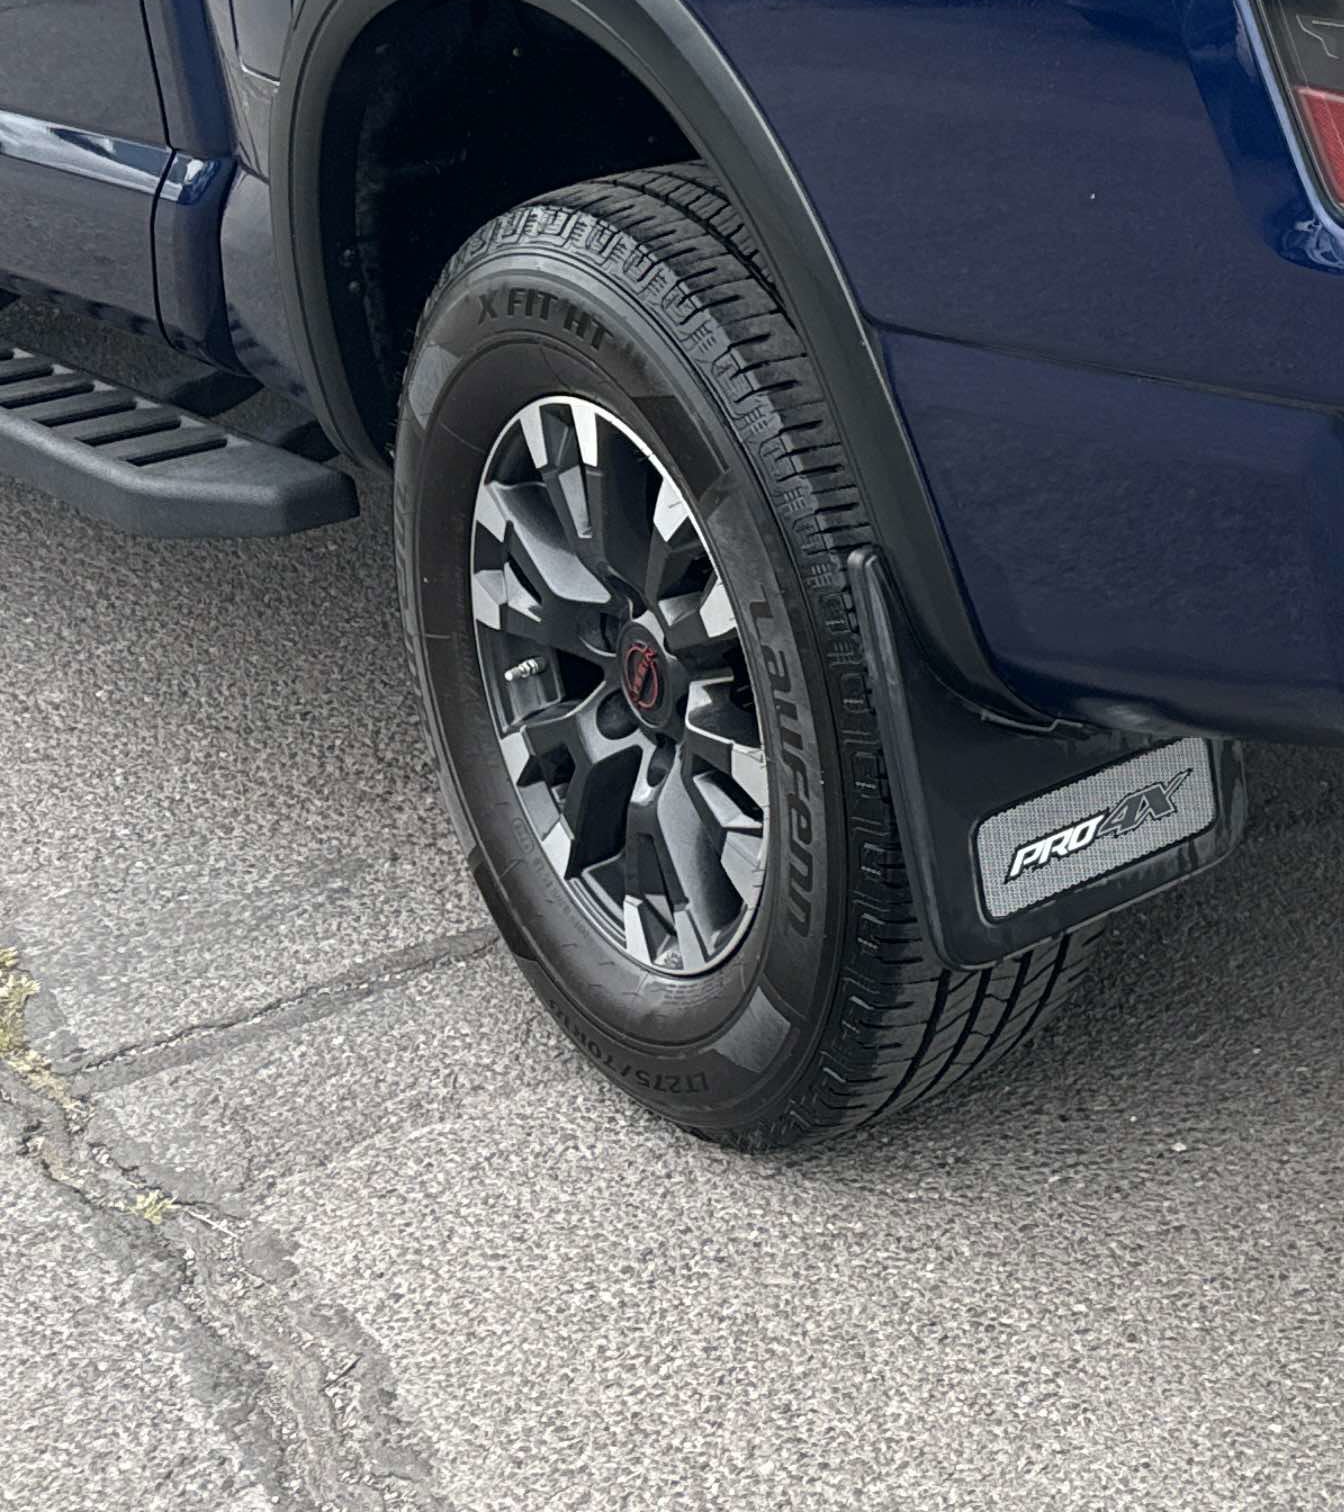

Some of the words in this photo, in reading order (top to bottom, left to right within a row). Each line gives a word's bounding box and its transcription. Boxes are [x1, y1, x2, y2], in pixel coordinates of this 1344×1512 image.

[477, 288, 499, 325] X
[506, 287, 559, 320] FIT
[563, 304, 615, 351] HT
[748, 583, 816, 938] Laufenn
